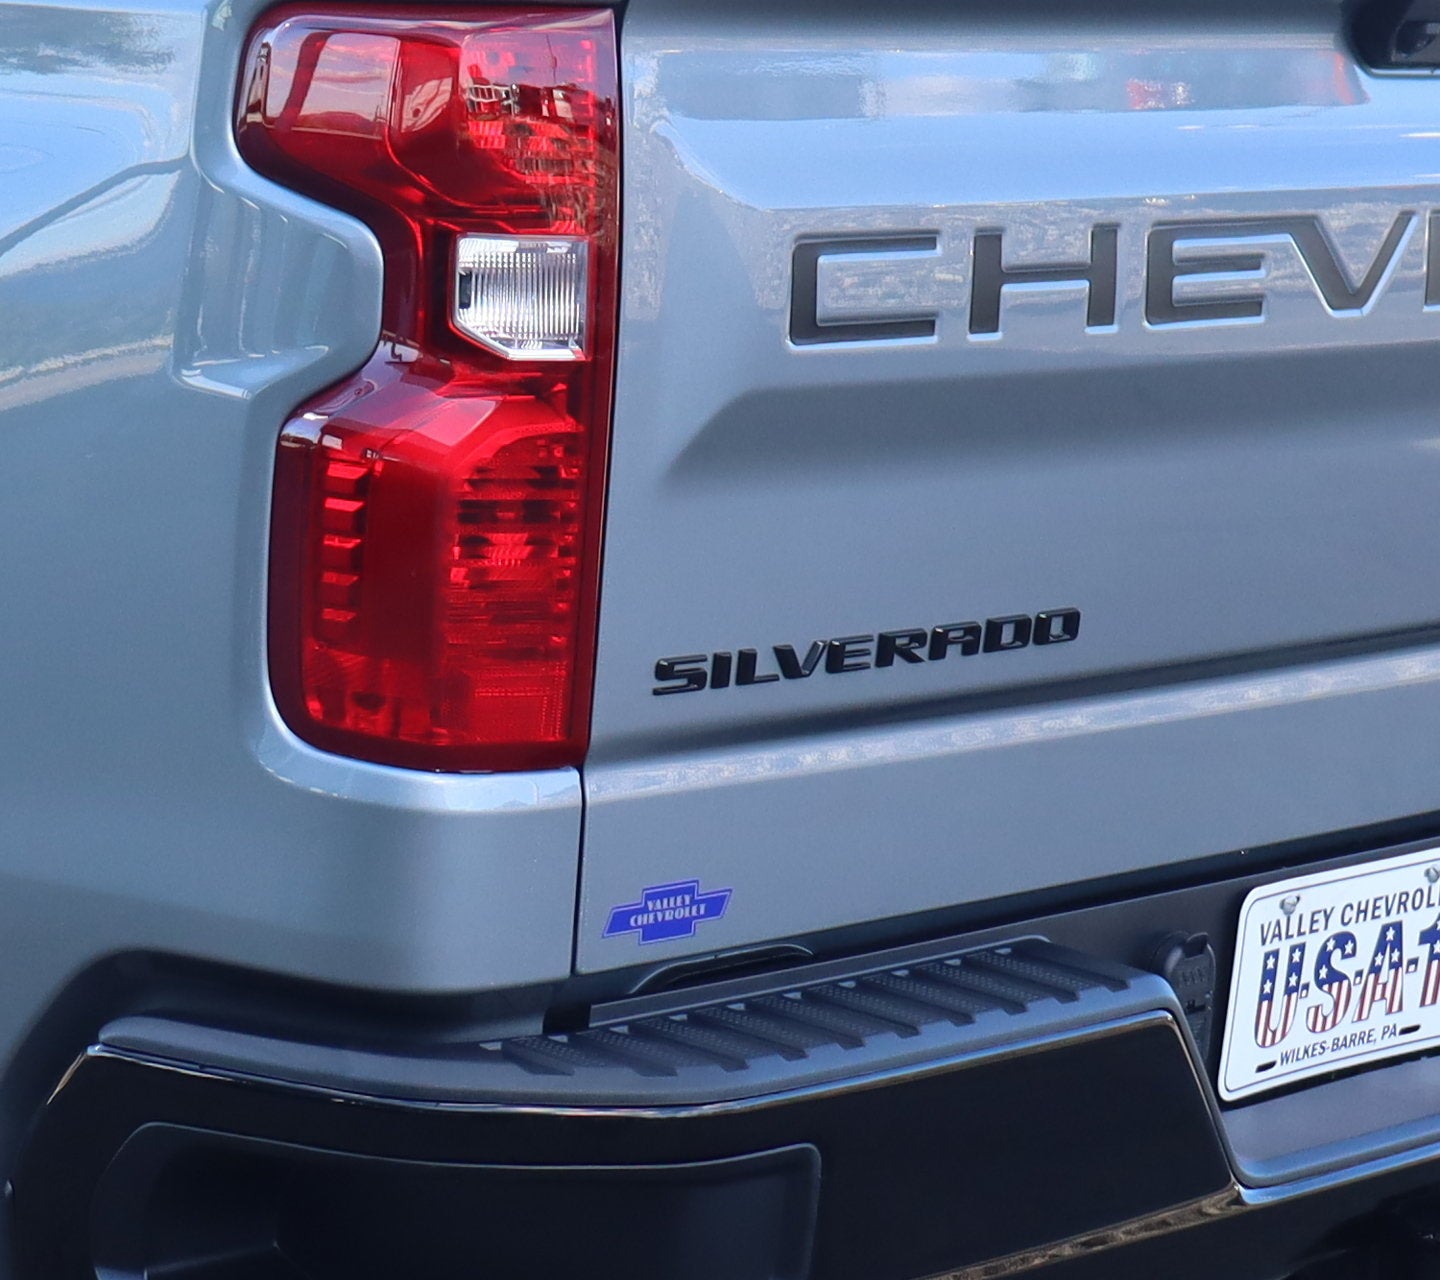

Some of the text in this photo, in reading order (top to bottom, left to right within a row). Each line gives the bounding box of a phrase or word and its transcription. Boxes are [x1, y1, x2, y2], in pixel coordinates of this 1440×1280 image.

[652, 607, 1080, 696] SILVERADO
[629, 903, 706, 927] CHEVROLET
[646, 893, 693, 912] VALLEY
[1260, 906, 1332, 946] VALLEY
[1279, 1023, 1398, 1066] WILKES-BARRE, PA
